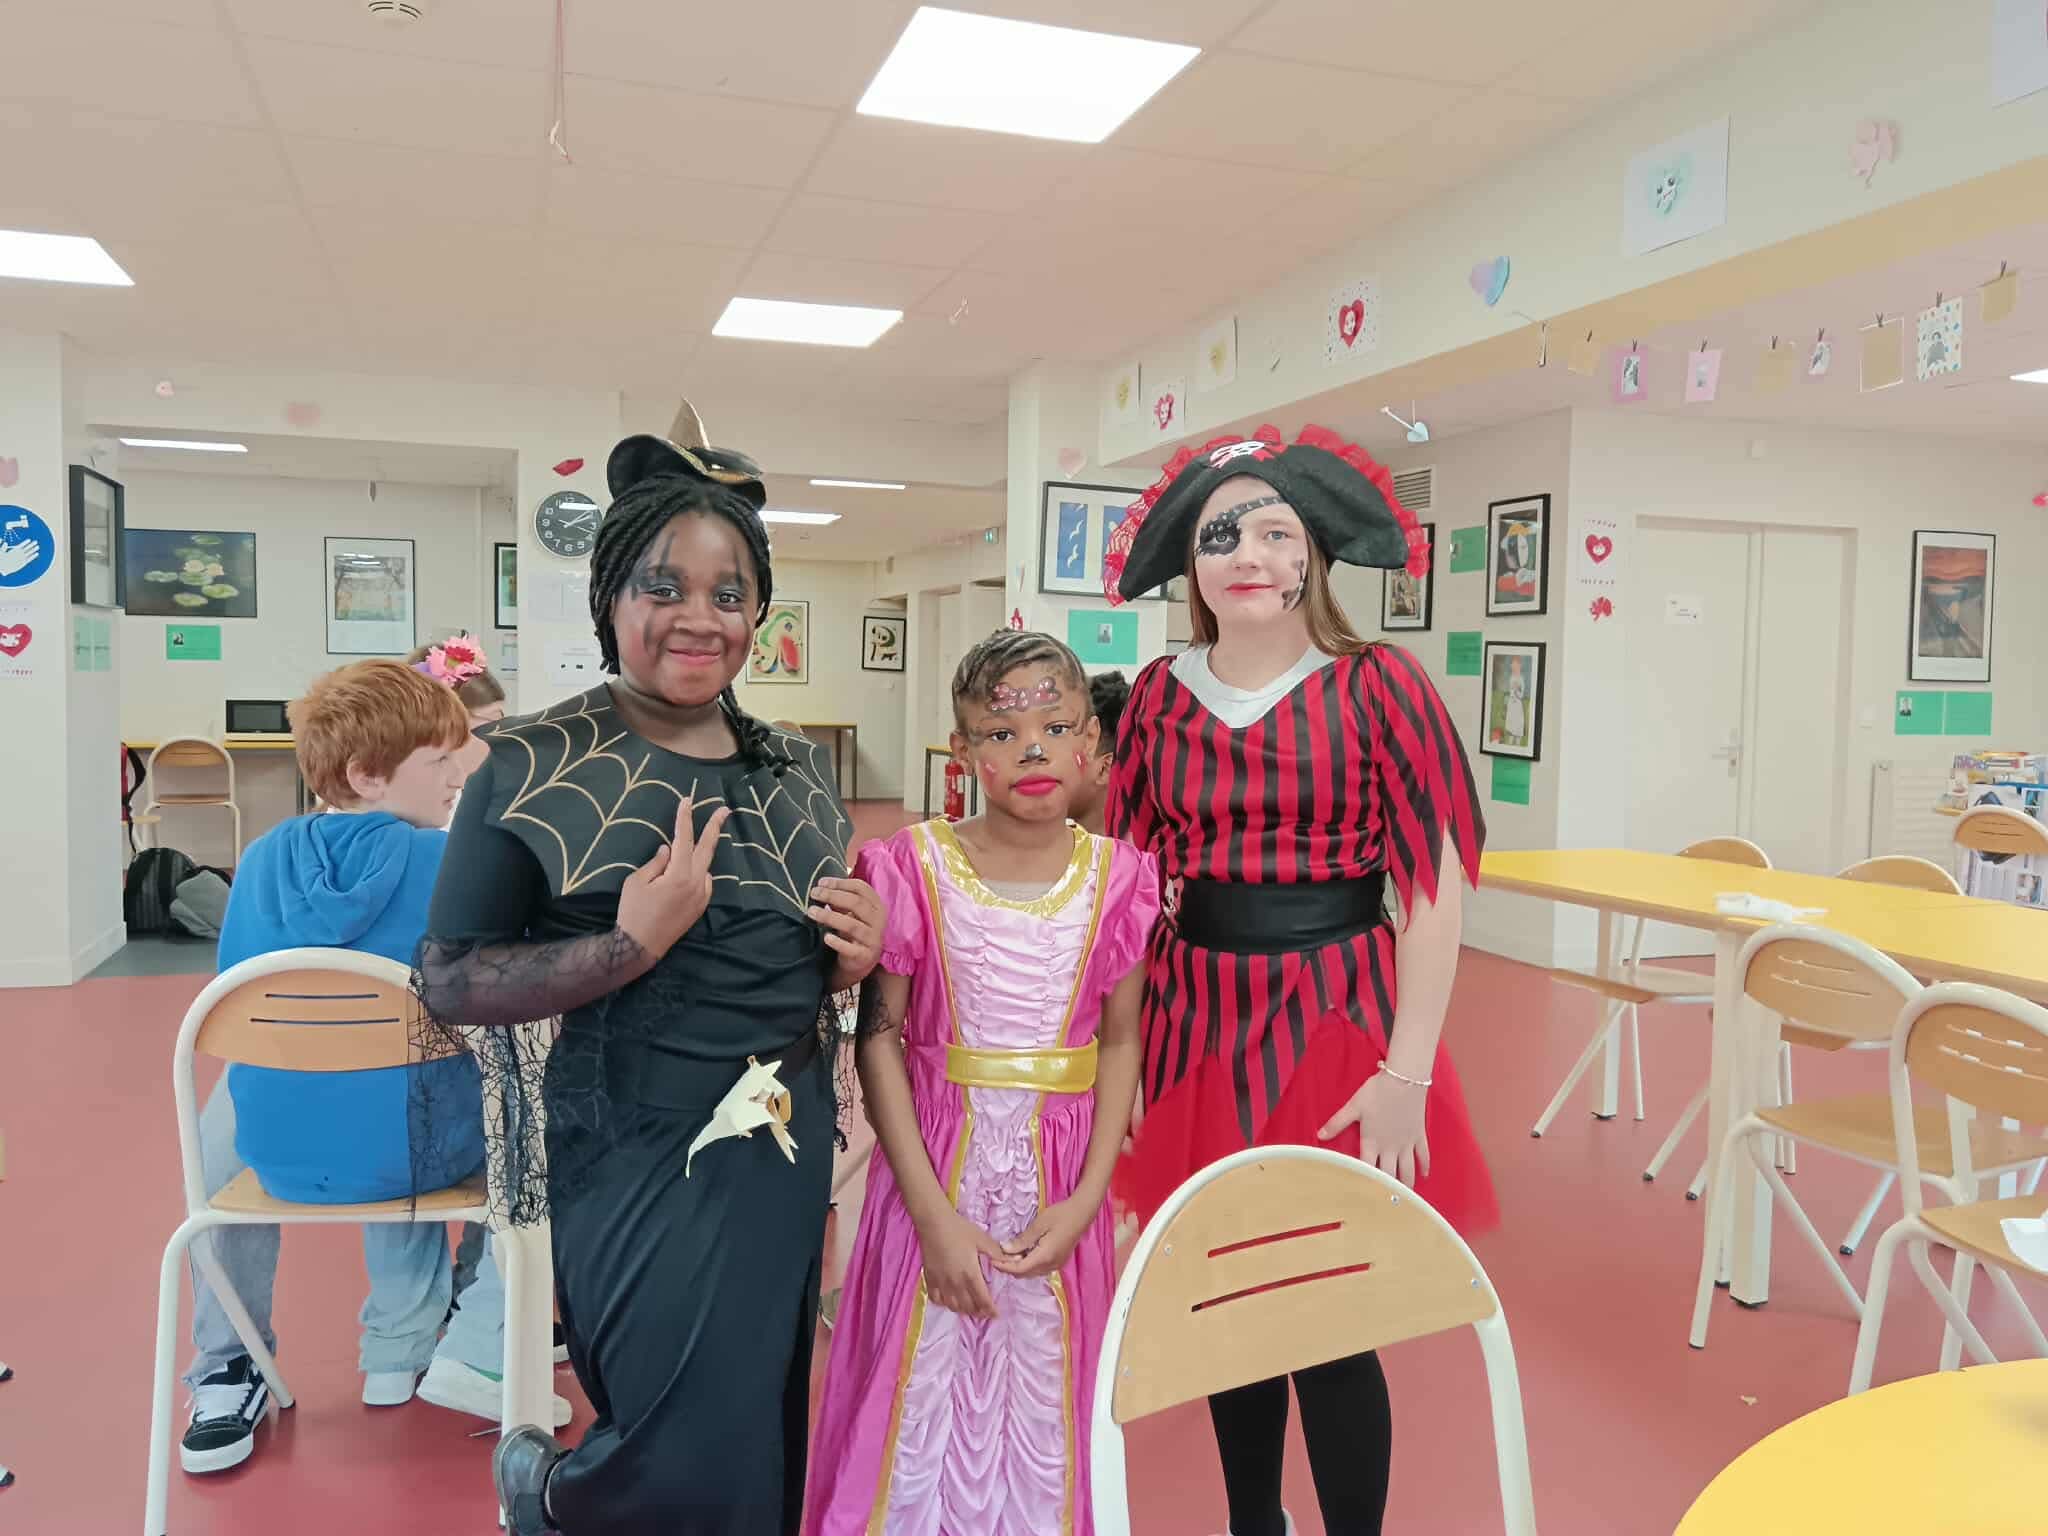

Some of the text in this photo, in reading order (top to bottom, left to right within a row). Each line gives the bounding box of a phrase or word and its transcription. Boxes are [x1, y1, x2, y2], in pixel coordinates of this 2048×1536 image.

[542, 518, 550, 526] 9
[553, 539, 560, 548] 7
[564, 544, 572, 552] 6
